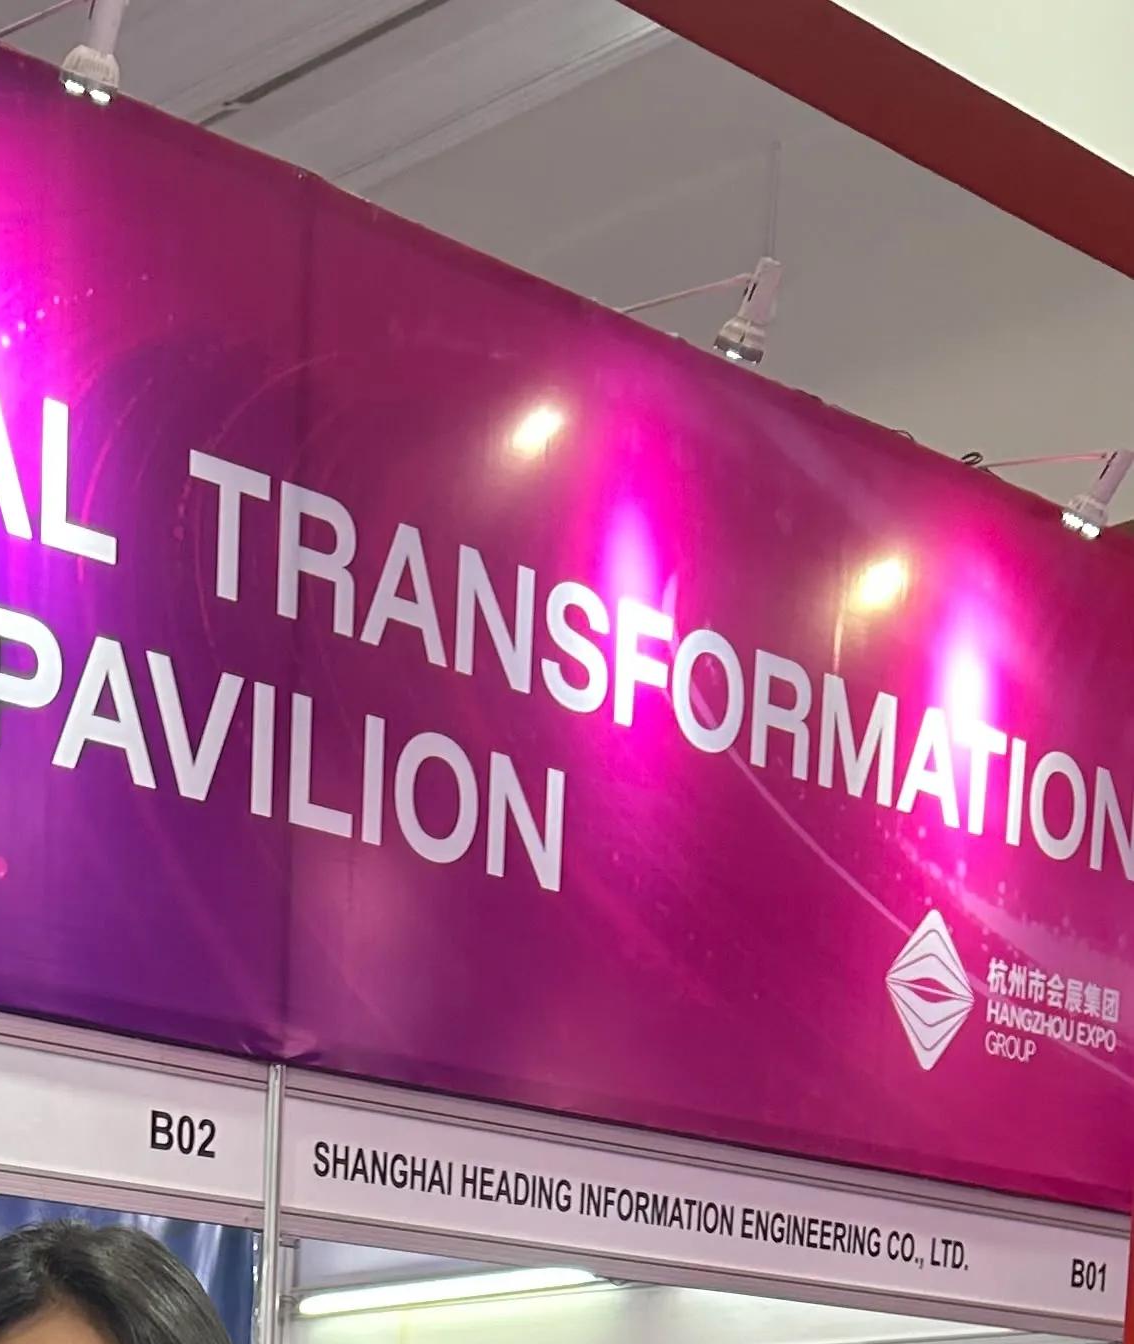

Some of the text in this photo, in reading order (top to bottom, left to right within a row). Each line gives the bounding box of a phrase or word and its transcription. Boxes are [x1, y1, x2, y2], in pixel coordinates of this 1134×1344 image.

[189, 449, 1134, 882] TRANSFORMATION
[986, 957, 1121, 1024] 杭州市会展集团
[985, 1030, 1038, 1063] GROUP
[986, 999, 1118, 1053] HANGZHOU EXPO
[150, 1109, 217, 1159] B02
[312, 1140, 970, 1272] SHANGHAI HEADING INFORMATION ENGINEERING CO., LTD.
[1070, 1257, 1108, 1293] B01
